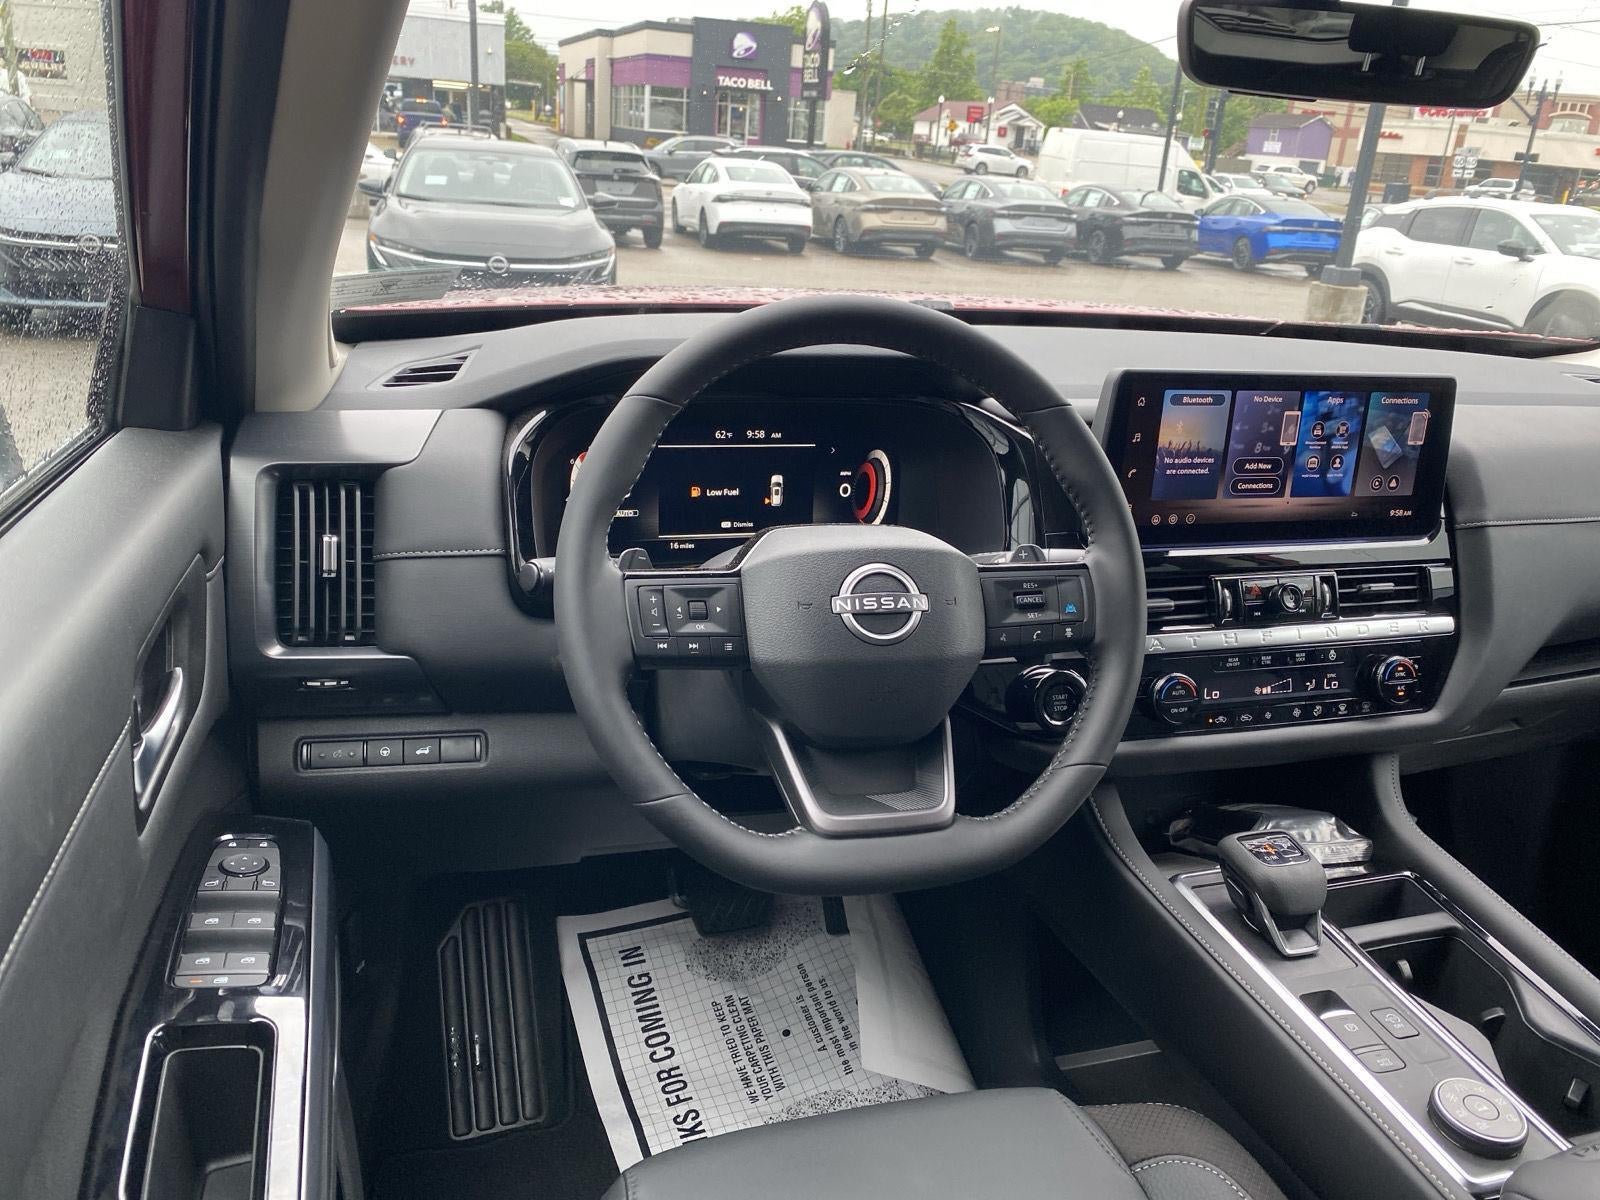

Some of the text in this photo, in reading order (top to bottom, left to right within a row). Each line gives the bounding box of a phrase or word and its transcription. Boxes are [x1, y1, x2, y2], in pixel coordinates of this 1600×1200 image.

[393, 56, 416, 66] ERY
[804, 69, 819, 82] BELL
[718, 76, 774, 90] TACO BELL
[1182, 396, 1213, 404] Bluetooth
[1327, 396, 1344, 405] Apps
[1381, 397, 1419, 405] Connections
[746, 430, 765, 439] 9:58
[1177, 467, 1209, 475] connected.
[1244, 462, 1258, 470] Add
[706, 488, 739, 497] Low Fuel
[840, 483, 851, 497] 0
[1237, 482, 1273, 490] Connections
[1389, 509, 1403, 517] 9:58
[836, 597, 927, 612] NISSAN
[1149, 621, 1429, 651] ATHFINDER
[619, 945, 646, 968] IN
[627, 972, 676, 1064] COMING
[796, 963, 854, 1075] the most important person
[818, 975, 858, 1052] in the world to us.
[795, 994, 828, 1052] A customer is
[724, 994, 774, 1101] YOUR CARPETING CLEAN
[739, 996, 786, 1092] WITH THIS PAPER MAT
[711, 1001, 760, 1104] WE HAVE TRIED TO KEEP
[656, 1065, 693, 1108] FOR
